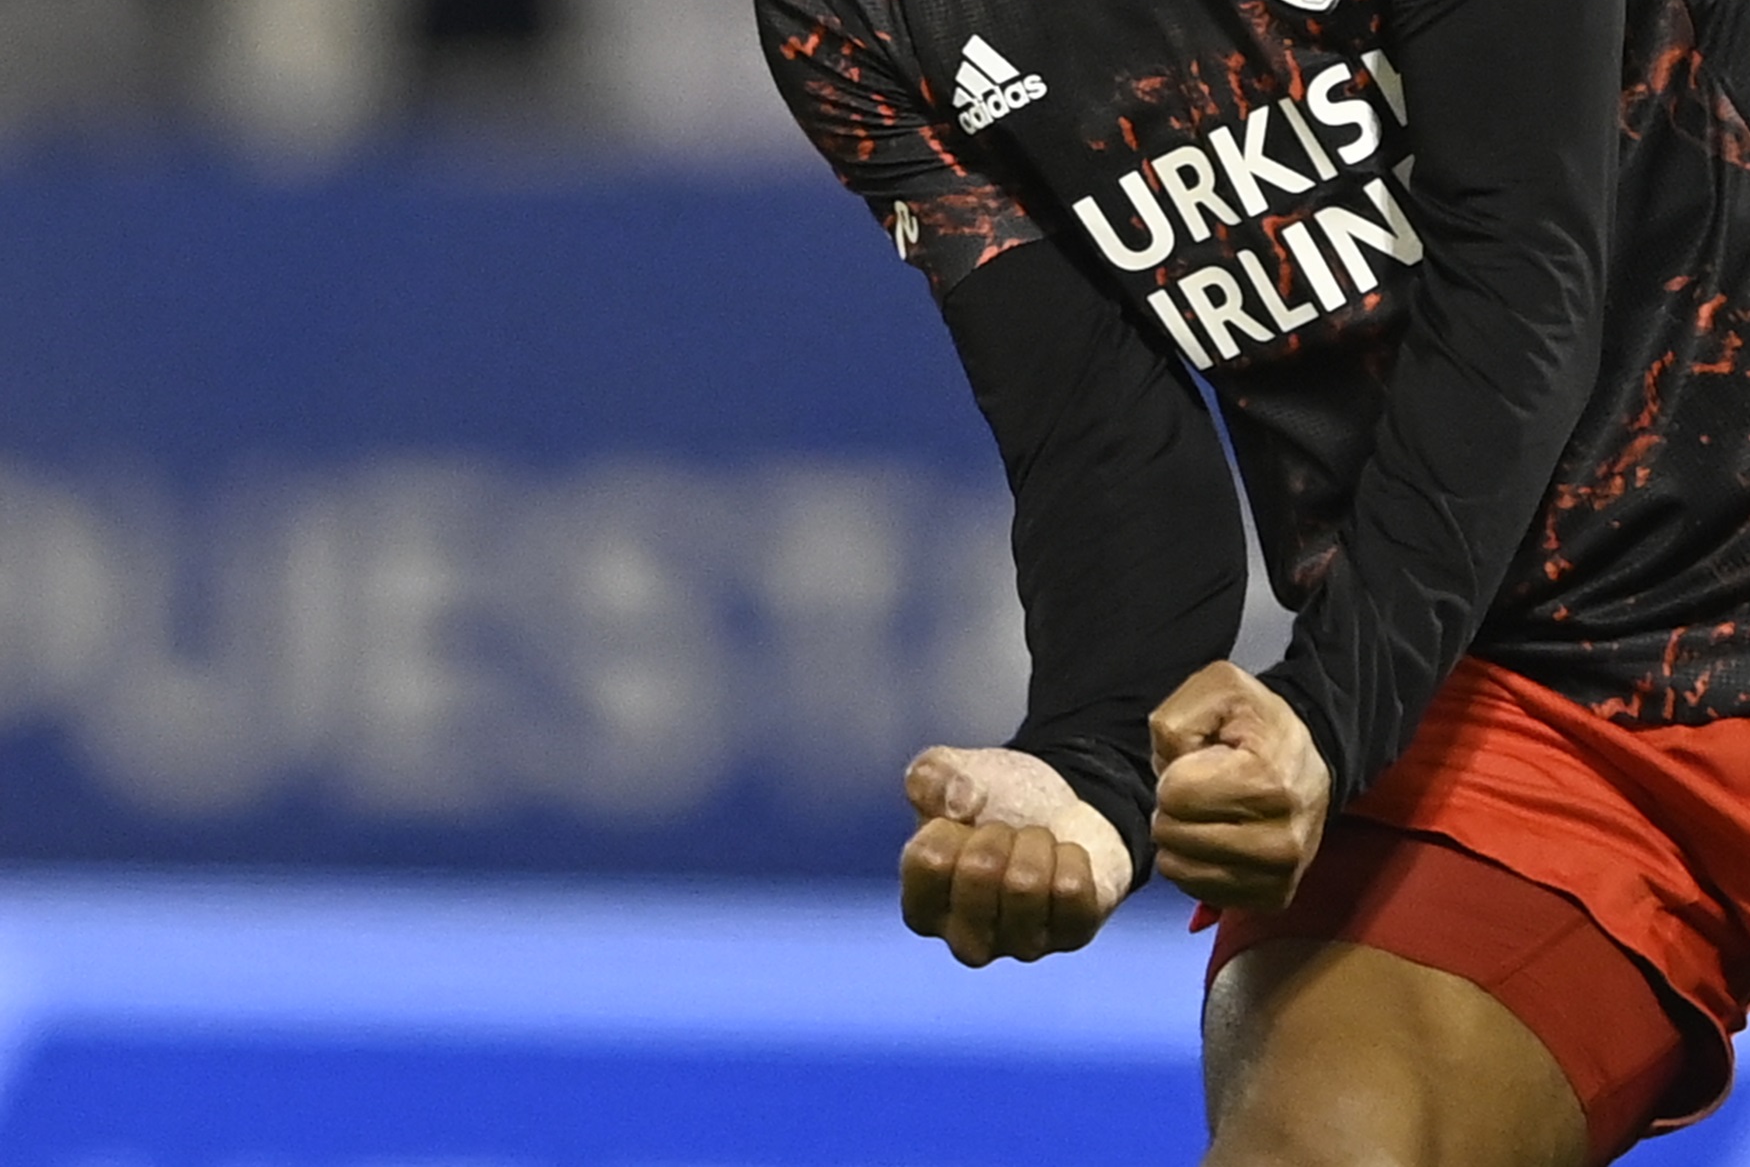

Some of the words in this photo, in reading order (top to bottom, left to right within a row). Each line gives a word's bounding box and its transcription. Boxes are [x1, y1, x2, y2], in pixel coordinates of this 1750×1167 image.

[958, 74, 1048, 135] adidas
[1072, 48, 1408, 272] URKIS
[1146, 154, 1424, 370] IRLIN
